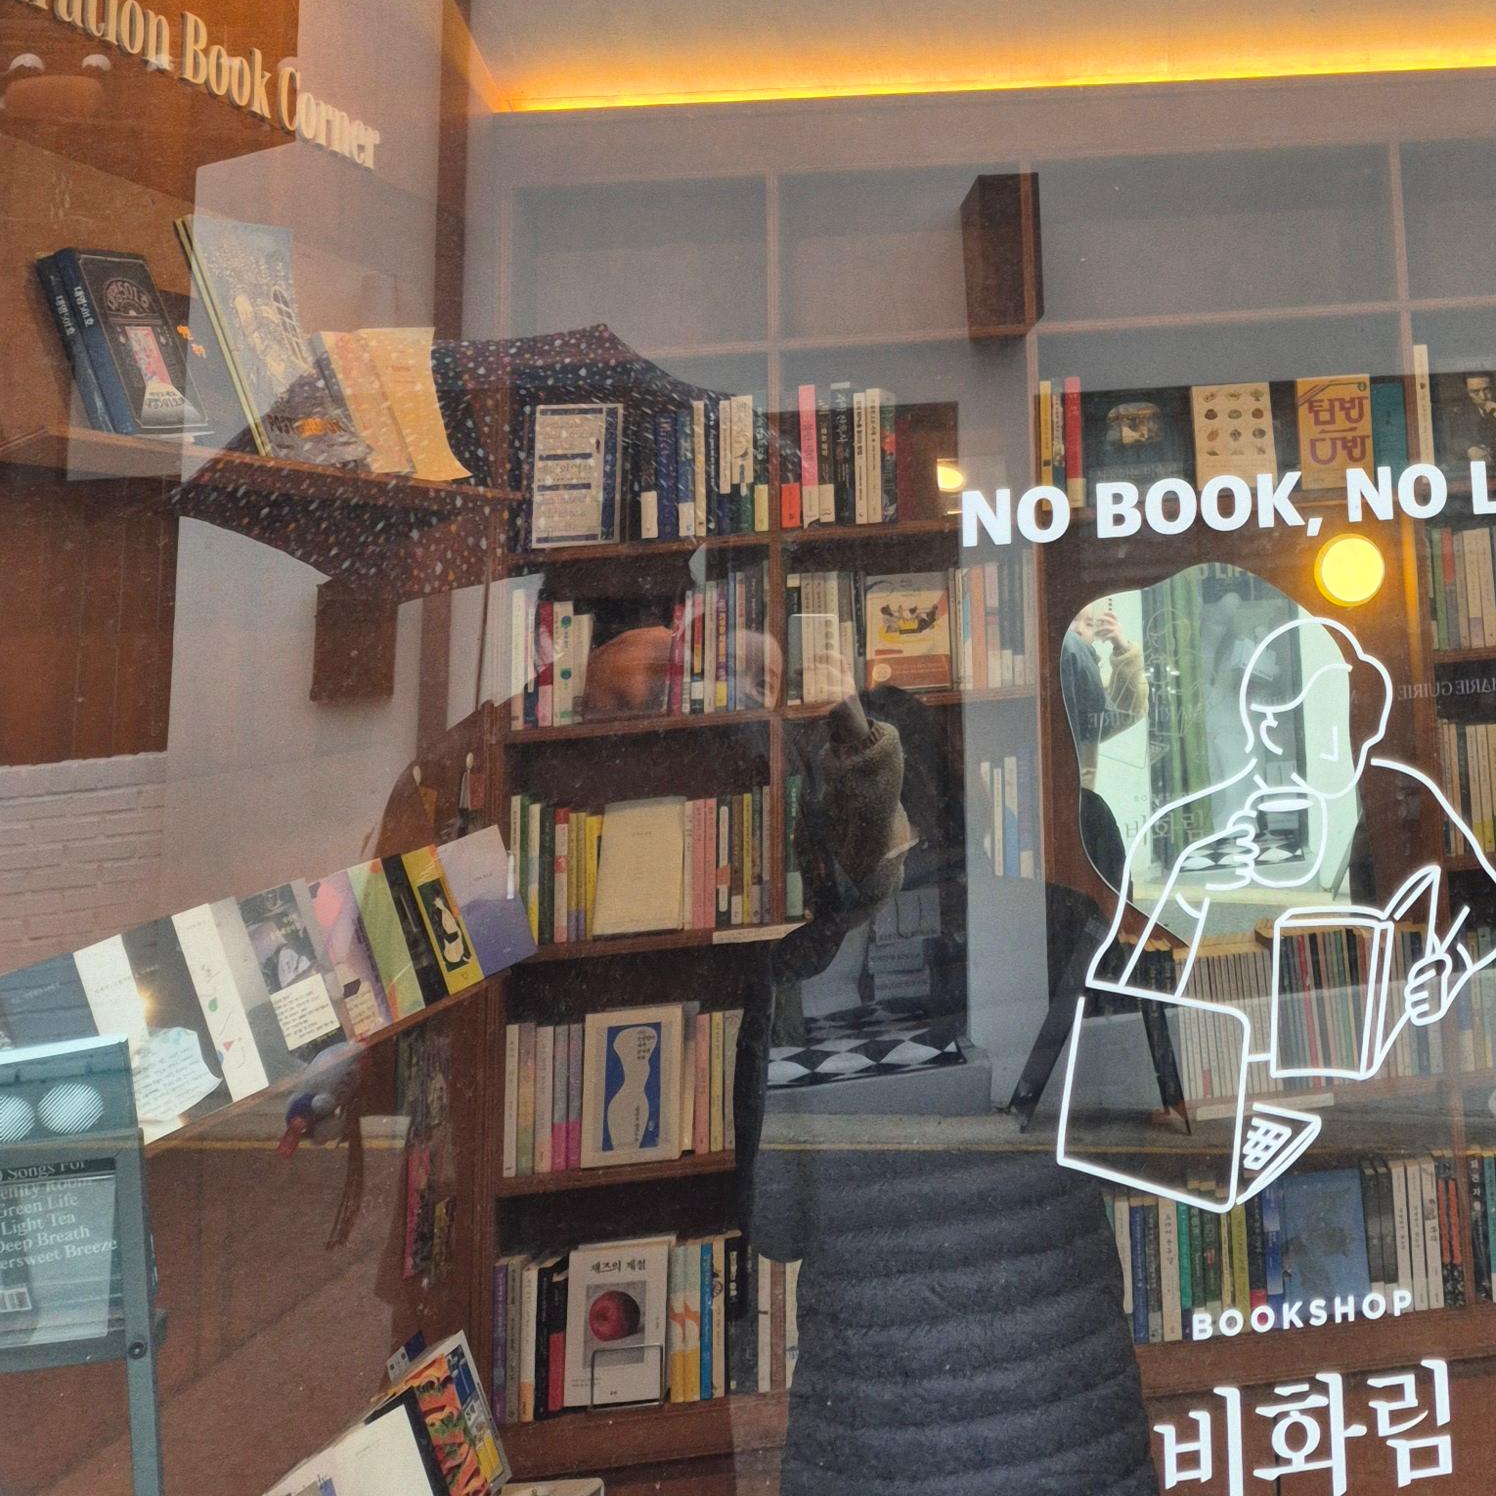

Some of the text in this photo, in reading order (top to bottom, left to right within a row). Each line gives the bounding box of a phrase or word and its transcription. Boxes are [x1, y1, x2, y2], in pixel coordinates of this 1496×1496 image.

[179, 11, 271, 119] Book
[278, 67, 380, 170] Corner
[961, 486, 1071, 548] NO
[1097, 472, 1323, 537] BOOK,
[1346, 464, 1449, 522] NO
[48, 1192, 79, 1210] Life
[2, 1212, 76, 1237] Light Tea
[38, 1225, 91, 1247] Breath
[0, 1239, 118, 1270] ersweet Breeze
[1192, 1290, 1413, 1341] BOOKSHOP
[1153, 1358, 1453, 1496] 비화림
